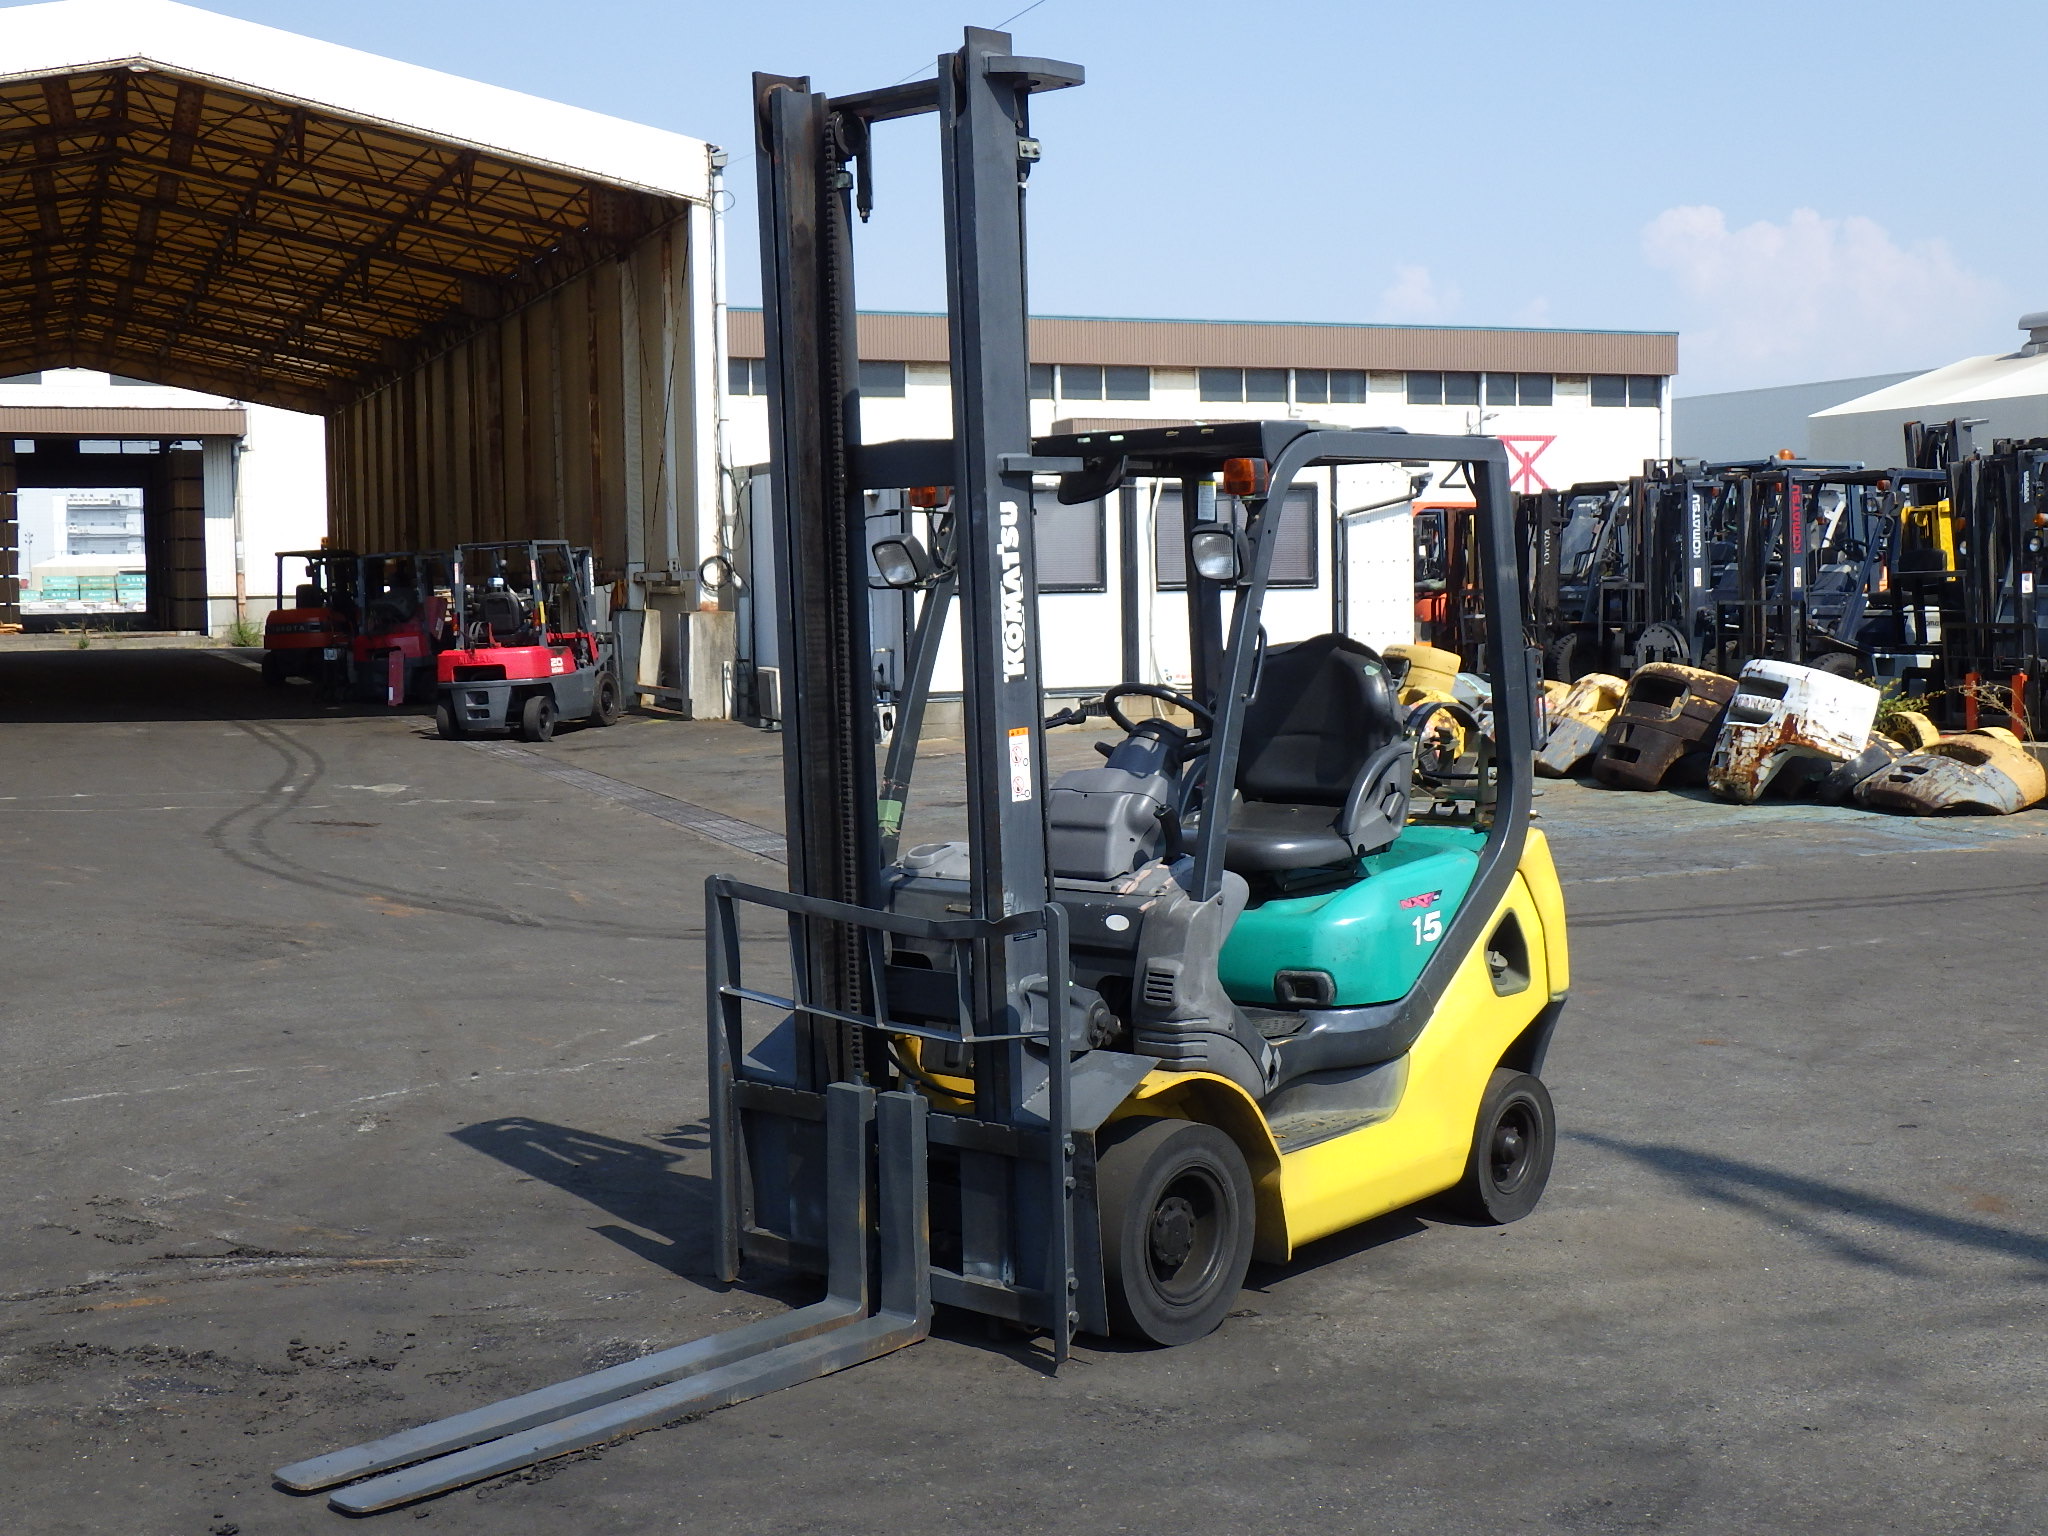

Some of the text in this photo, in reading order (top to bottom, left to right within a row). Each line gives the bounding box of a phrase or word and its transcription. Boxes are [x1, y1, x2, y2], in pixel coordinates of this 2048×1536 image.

[1692, 494, 1701, 558] KOMATSU
[1793, 484, 1802, 554] KOMATSU
[997, 500, 1026, 680] KOMATSU
[550, 657, 563, 666] 20
[1411, 910, 1443, 946] 15
